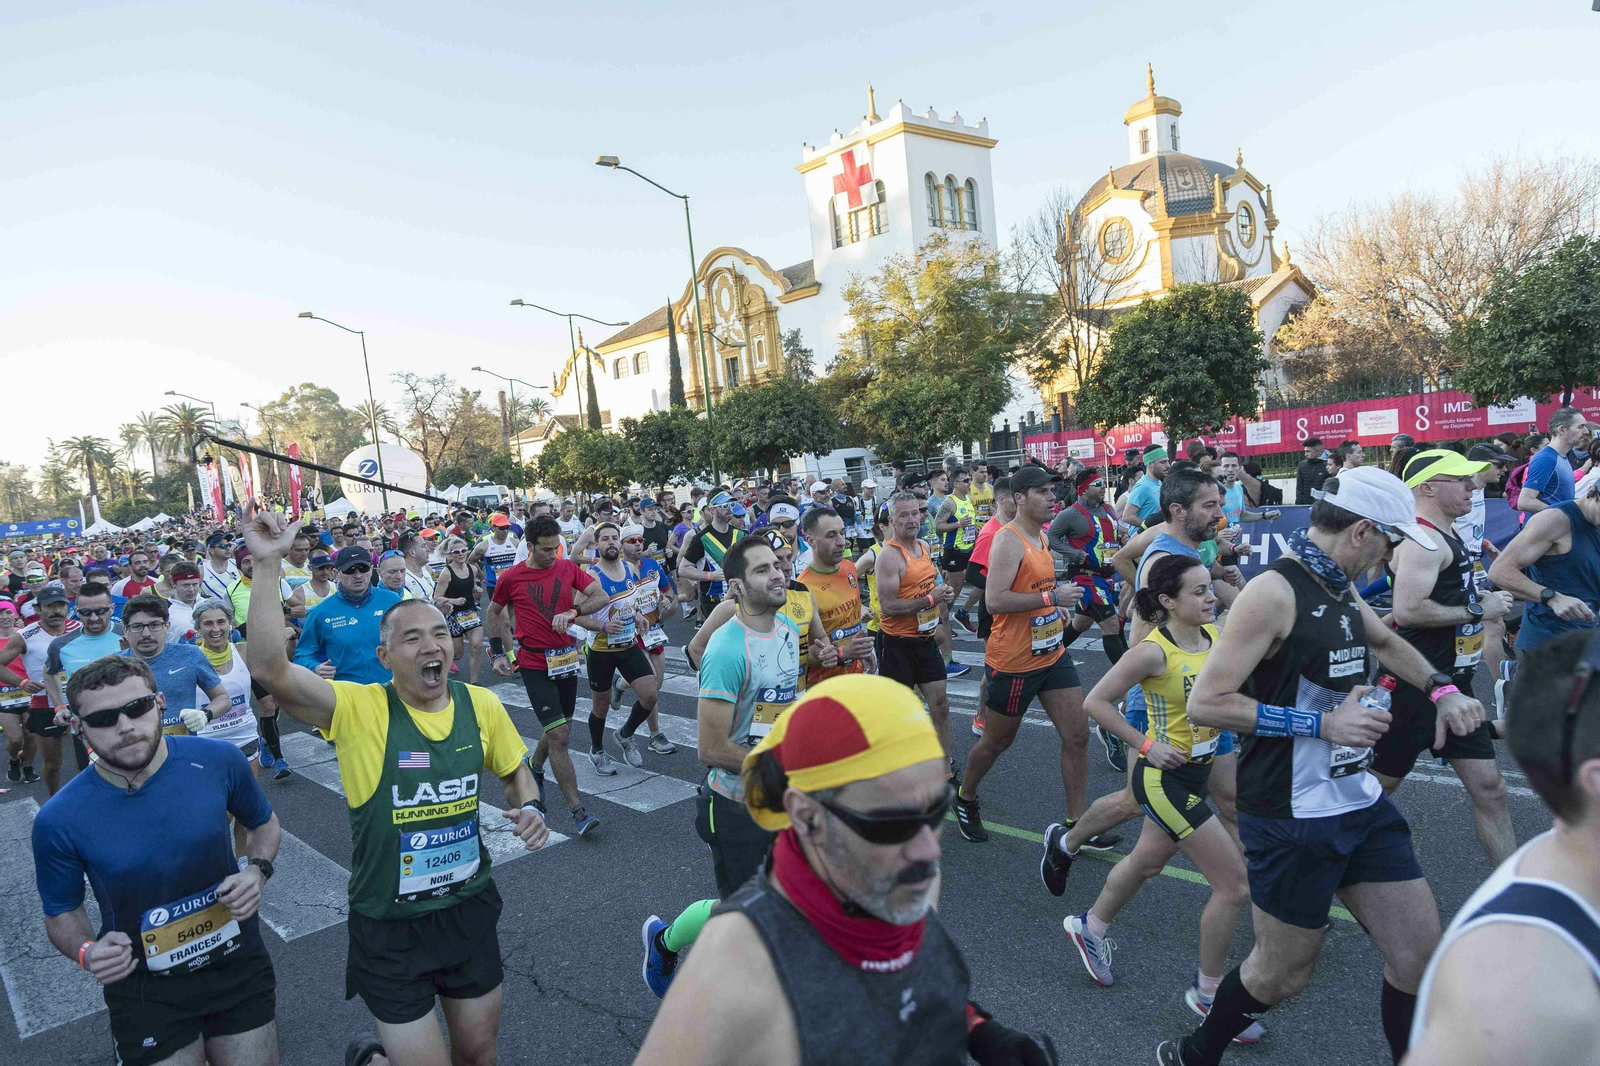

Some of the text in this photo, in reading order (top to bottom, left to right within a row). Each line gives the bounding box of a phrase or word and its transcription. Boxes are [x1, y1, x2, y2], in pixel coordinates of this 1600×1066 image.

[1443, 400, 1472, 414] IMD
[1320, 413, 1345, 426] IMD
[1450, 421, 1474, 430] Deportes
[1456, 416, 1481, 425] Municipal
[1313, 427, 1353, 436] Instituto Municipal
[1326, 432, 1346, 441] Deportes
[1124, 433, 1143, 444] IMD
[163, 716, 182, 725] RICH
[391, 774, 478, 807] LASD
[395, 799, 478, 821] RUNNING TEAM
[1185, 797, 1202, 811] adidas
[430, 826, 471, 845] ZURICH
[424, 850, 461, 869] 12406
[430, 873, 454, 886] NONE
[177, 920, 213, 943] 5409
